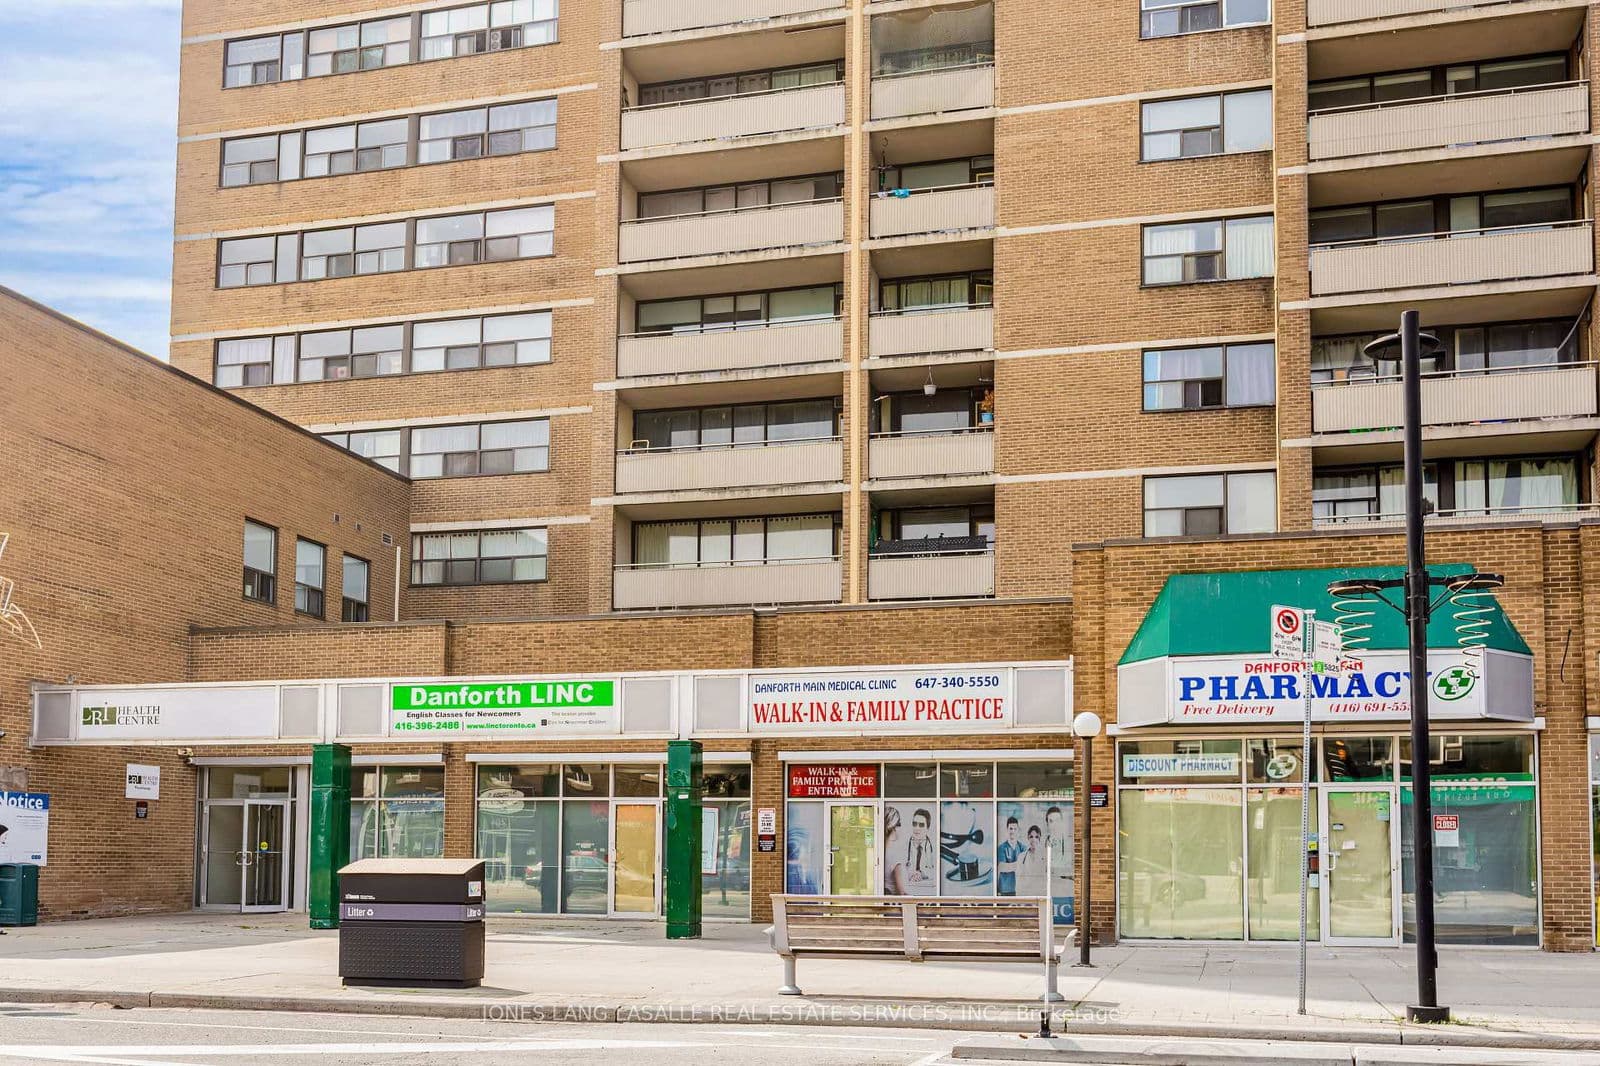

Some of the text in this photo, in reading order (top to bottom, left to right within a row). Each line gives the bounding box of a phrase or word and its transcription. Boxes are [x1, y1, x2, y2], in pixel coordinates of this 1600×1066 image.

[1244, 661, 1307, 674] DANFORT
[755, 679, 897, 693] DANFORTH MAIN MEDICAL CLINIC
[915, 675, 999, 688] 647-340-5550
[410, 683, 594, 706] Danforth LINC
[118, 705, 160, 715] HEALTH
[753, 698, 1004, 723] WALK-IN & FAMILY PRACTICE
[1183, 703, 1275, 716] Free Delivery
[1329, 701, 1410, 714] (416) 691-55
[117, 715, 160, 726] CENTRE
[406, 711, 433, 719] English
[1180, 758, 1233, 771] PHARMACY
[808, 767, 858, 776] WALK-IN &
[792, 776, 874, 786] FAMILY PRACTICE
[808, 786, 858, 796] ENTRANCE
[347, 907, 366, 917] Litter
